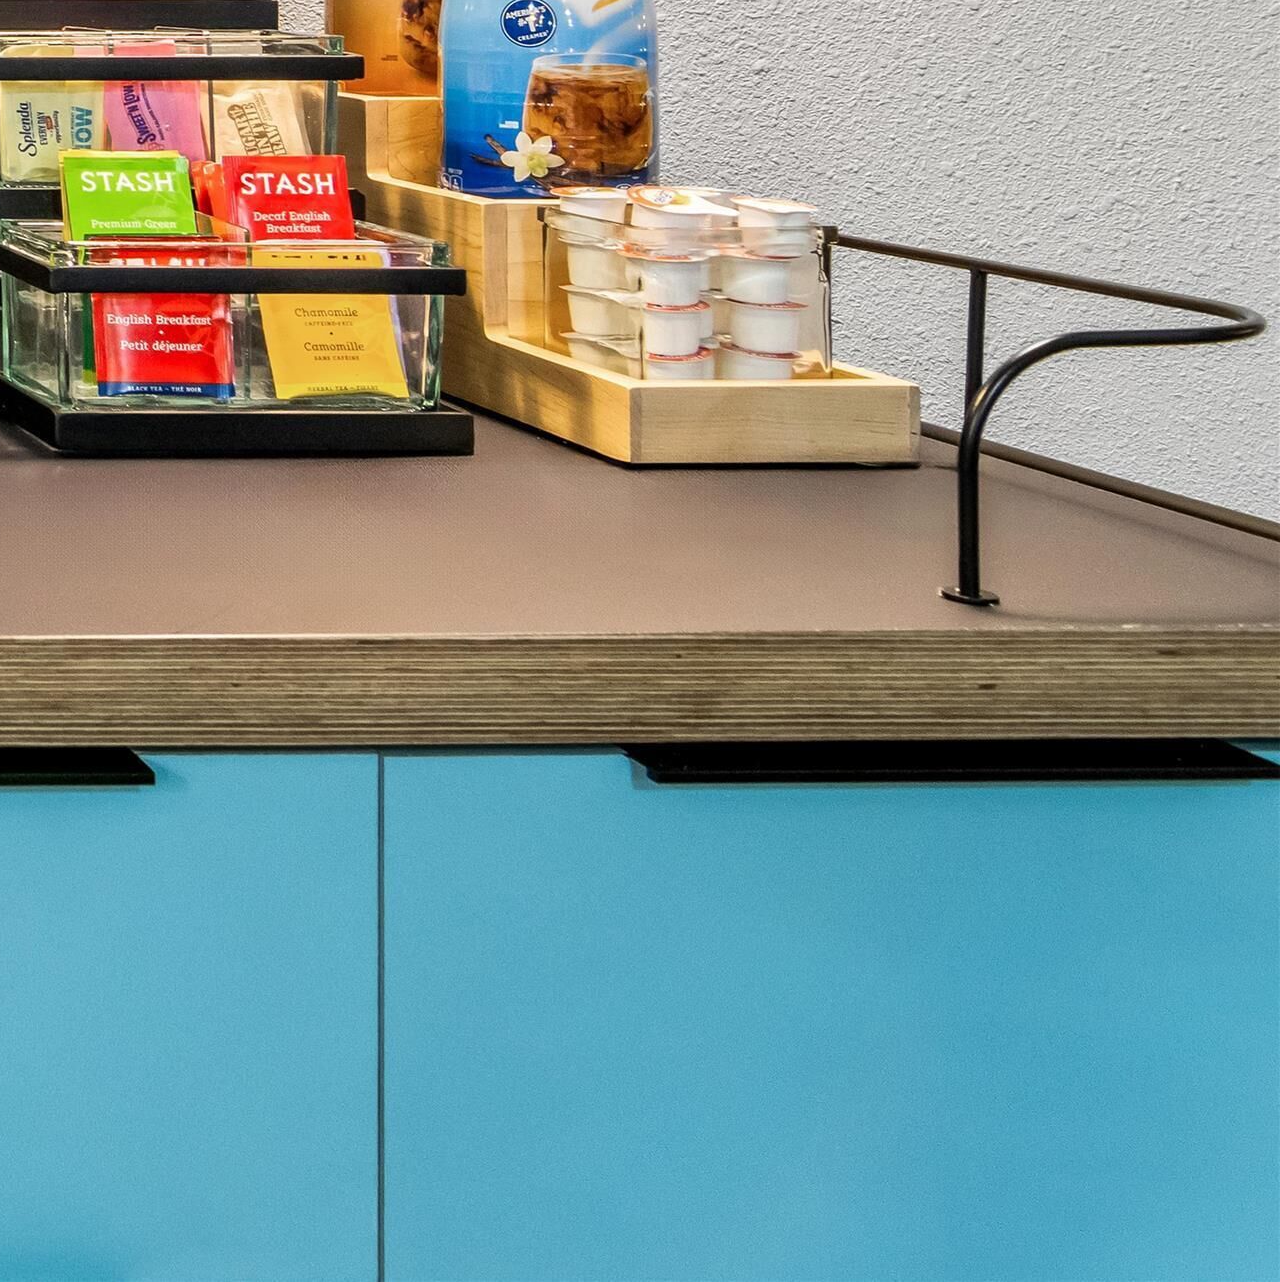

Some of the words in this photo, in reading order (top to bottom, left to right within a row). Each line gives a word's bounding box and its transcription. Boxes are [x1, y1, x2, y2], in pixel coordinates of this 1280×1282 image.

[16, 102, 37, 156] Splenda
[232, 109, 259, 156] UGAR
[81, 171, 176, 192] STASH
[240, 173, 336, 195] STASH
[253, 211, 287, 221] Decaf
[289, 211, 331, 223] English
[91, 219, 141, 229] Premium
[144, 219, 177, 229] Green
[266, 223, 321, 234] Breakfast
[294, 307, 359, 317] Chamomile
[106, 314, 152, 326] English
[156, 315, 212, 325] Breakfast
[120, 340, 148, 350] Petit
[152, 340, 203, 353] déjeuner
[304, 341, 365, 351] Camomille
